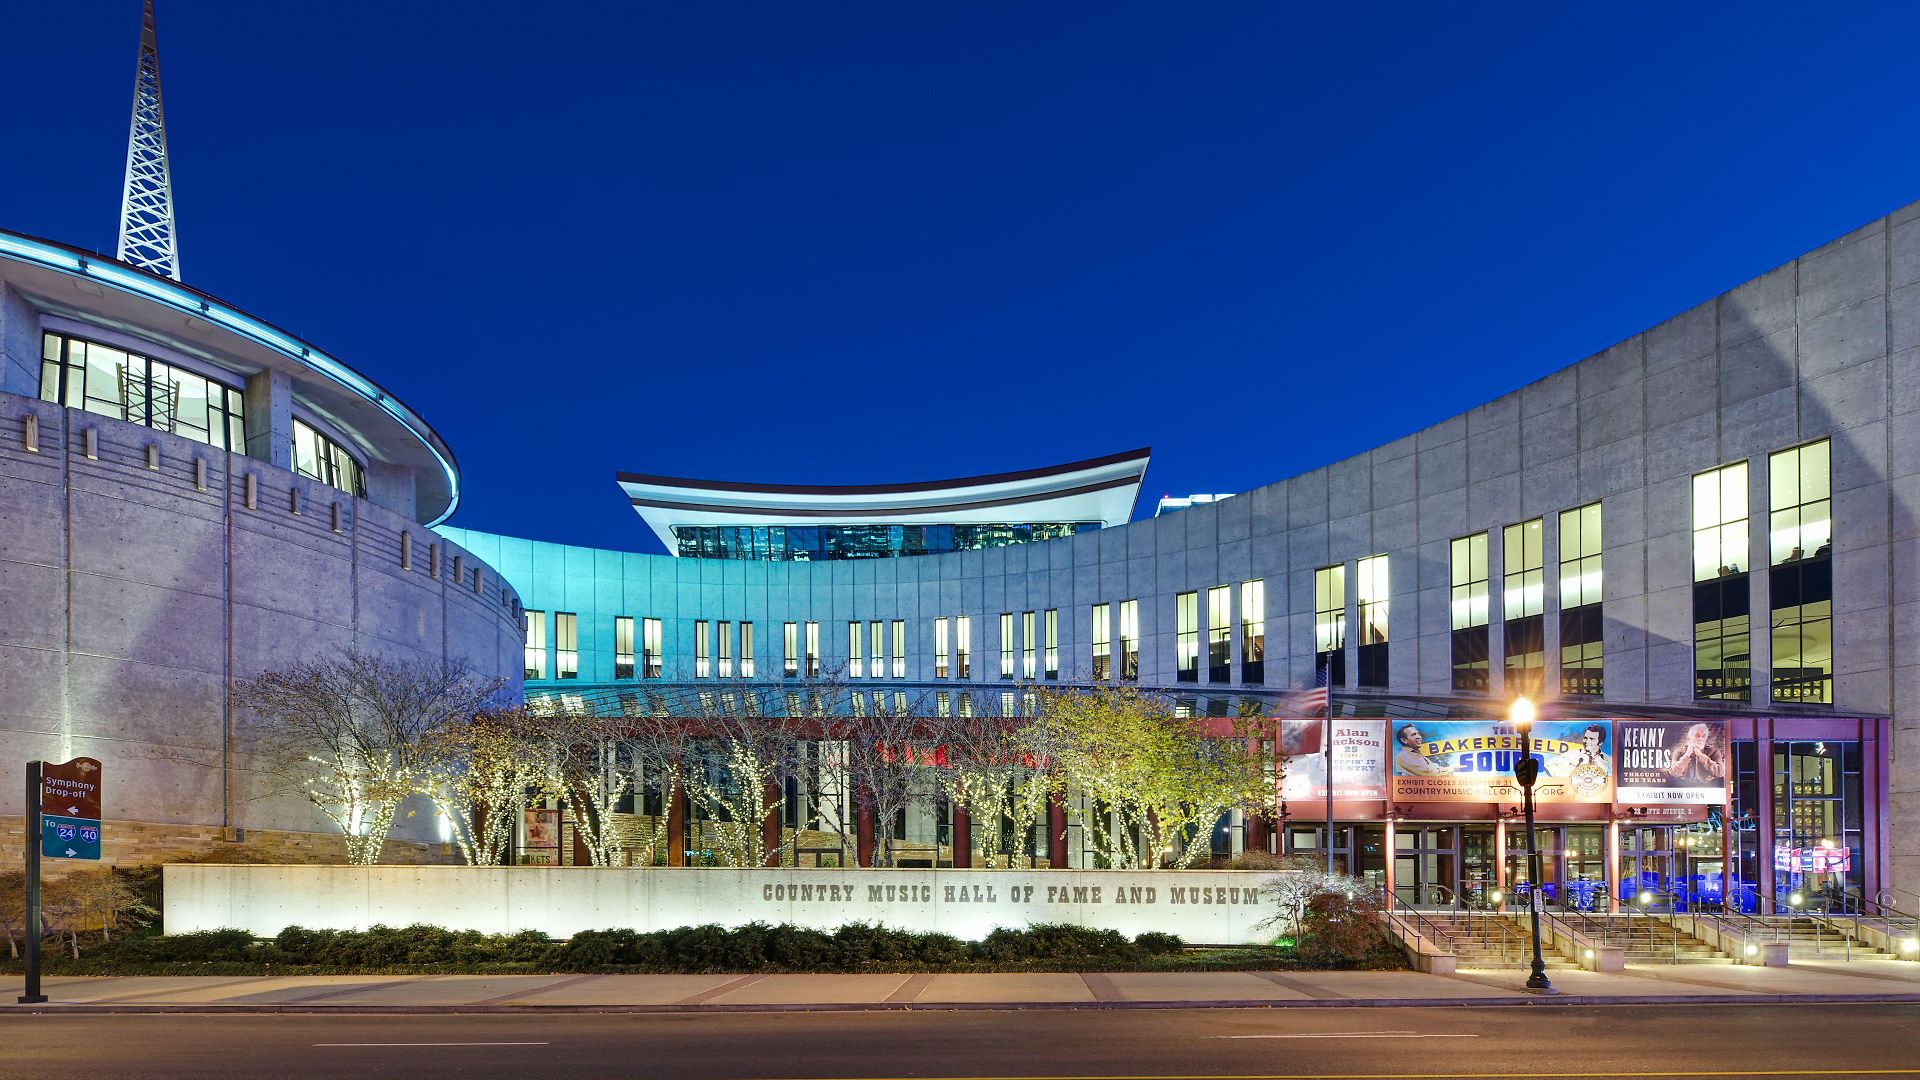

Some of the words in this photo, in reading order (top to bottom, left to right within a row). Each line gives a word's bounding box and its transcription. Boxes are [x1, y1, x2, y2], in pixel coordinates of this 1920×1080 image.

[1336, 729, 1369, 737] Alan
[1625, 728, 1665, 747] KENNY
[1325, 738, 1380, 747] ackson
[1429, 736, 1569, 755] BAKERSFELD
[1624, 749, 1671, 768] ROGERS
[46, 777, 95, 791] Symphony
[45, 787, 86, 798] Drop-off
[1637, 791, 1665, 799] EXHIBIT
[1667, 791, 1684, 799] NOW
[1685, 791, 1705, 799] OPEN
[45, 820, 56, 828] To
[60, 828, 74, 838] 24
[82, 830, 97, 840] 40
[763, 884, 854, 902] COUNTRY
[868, 884, 931, 903] MUSIC
[944, 885, 997, 903] HALL
[1010, 885, 1034, 903] OF
[1047, 886, 1102, 903] FAME
[1115, 886, 1157, 904] AND
[1170, 887, 1259, 904] MUSEUM
